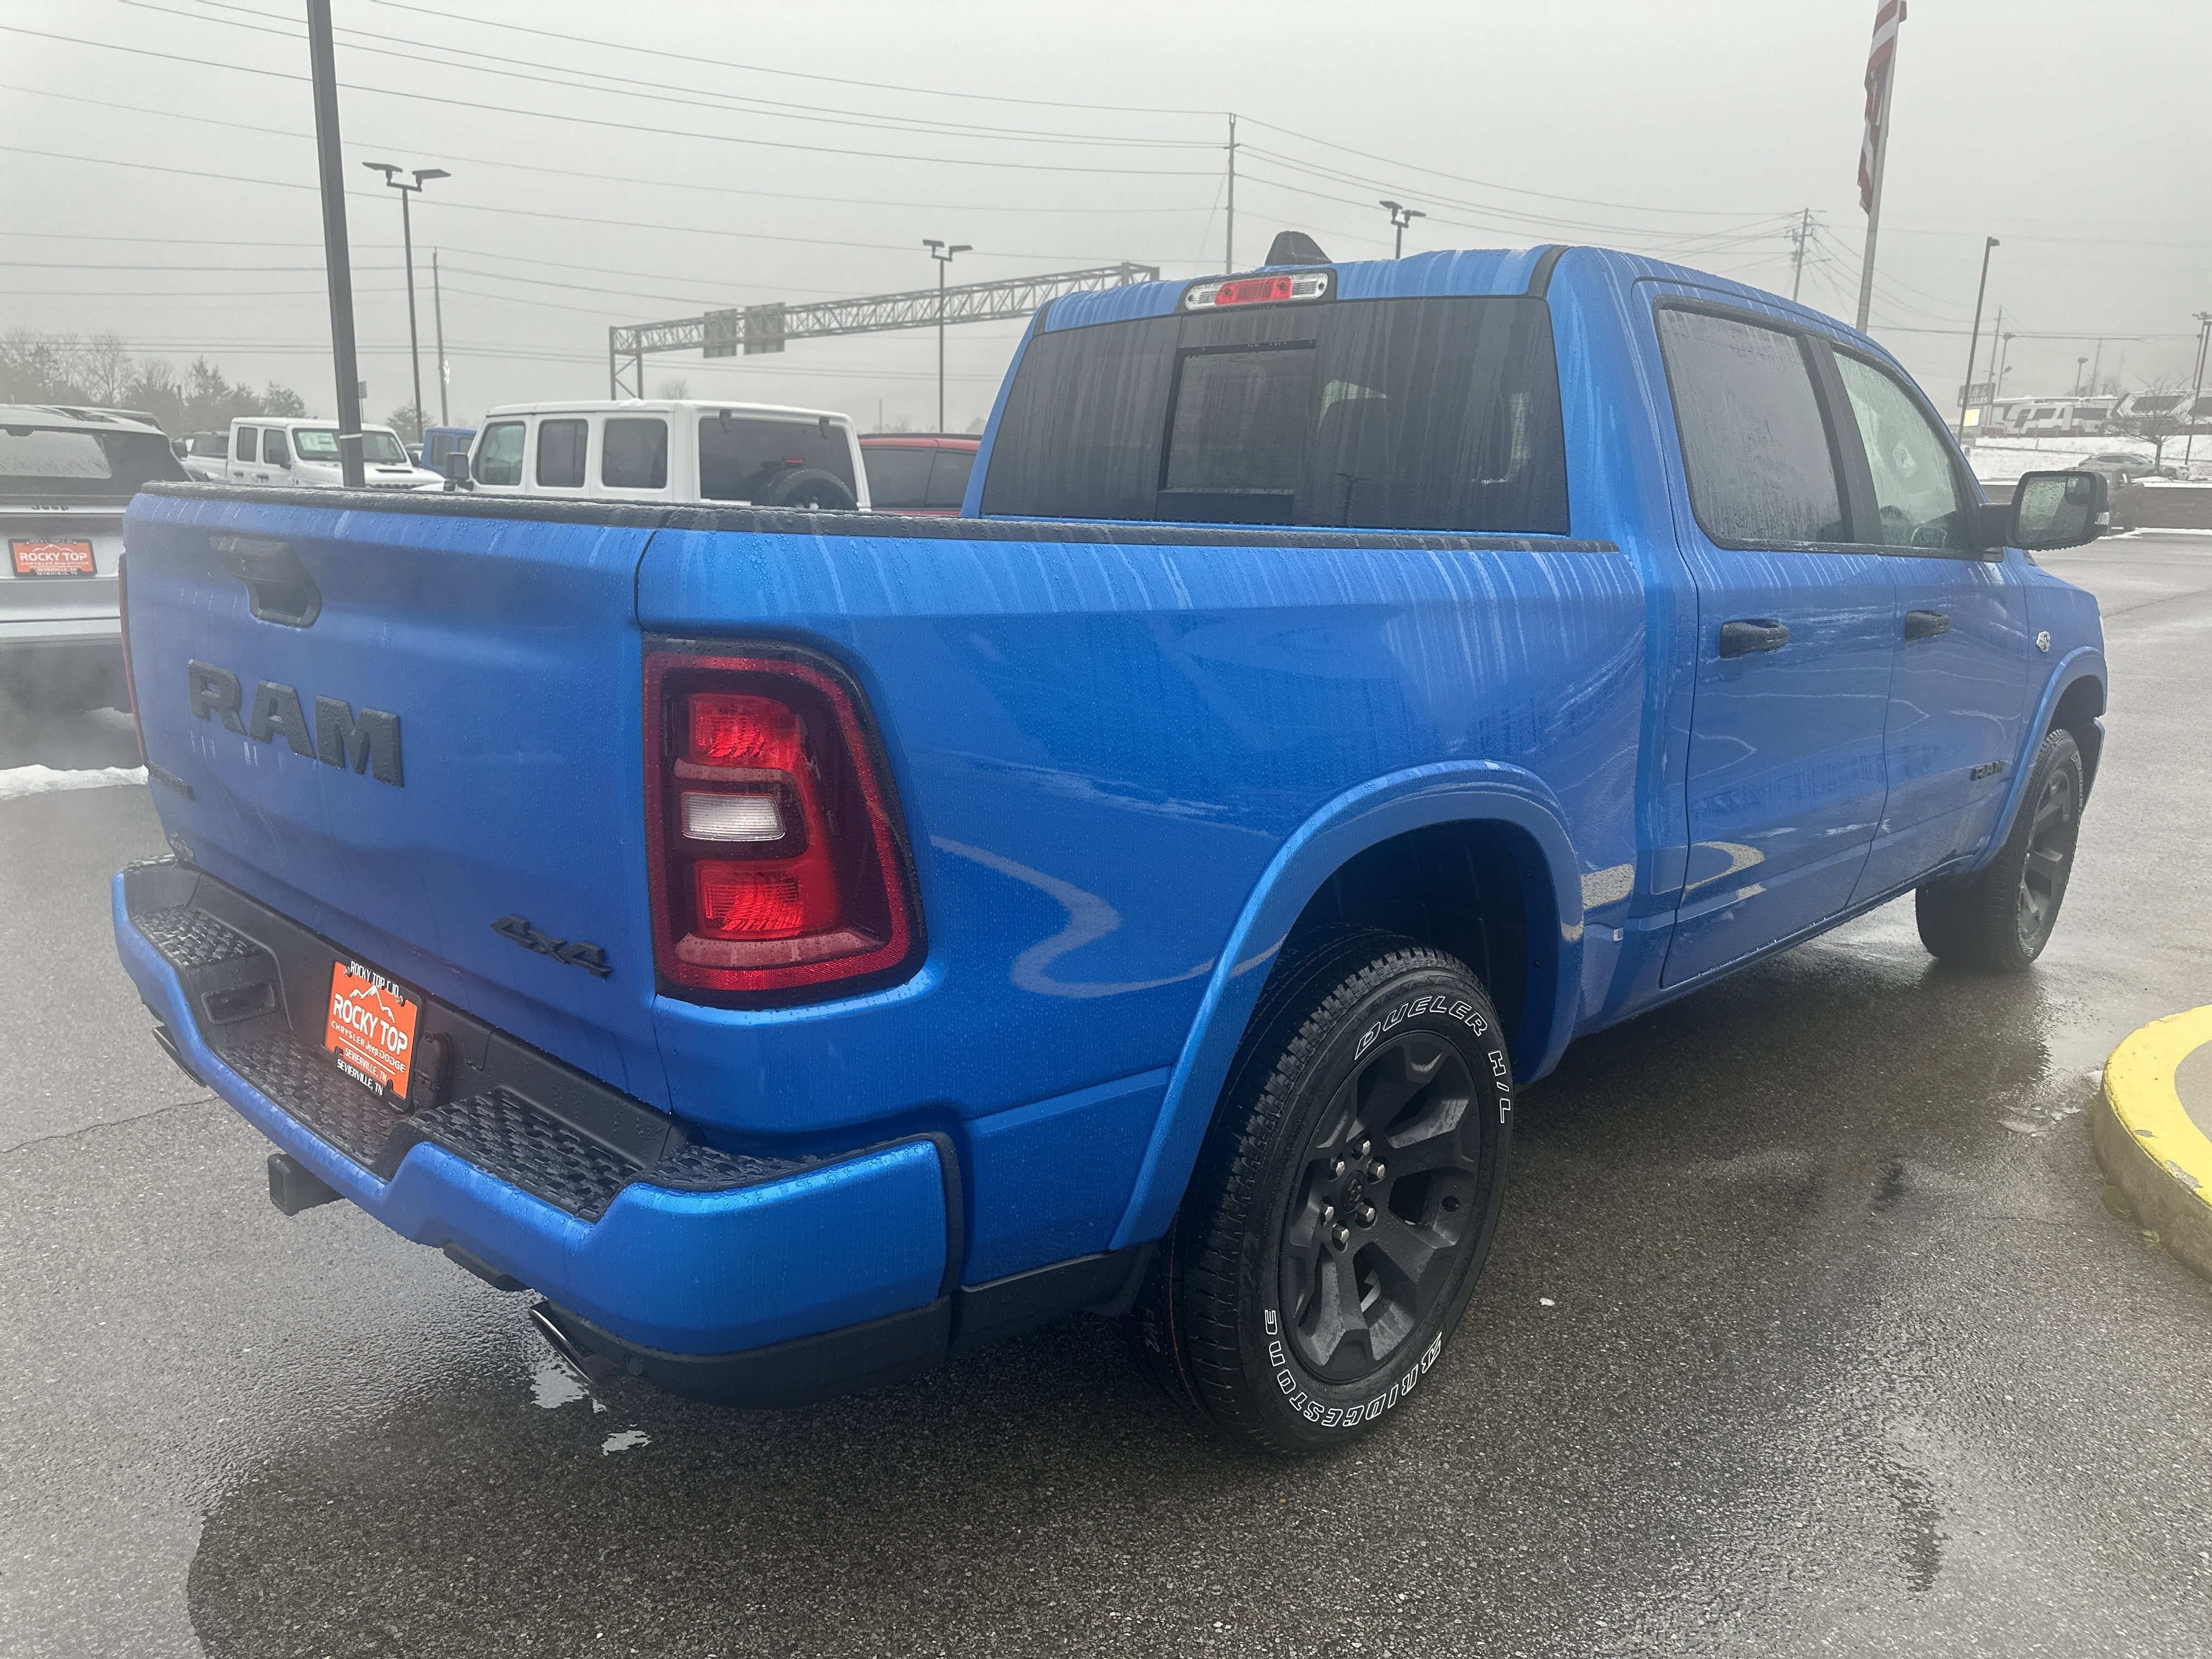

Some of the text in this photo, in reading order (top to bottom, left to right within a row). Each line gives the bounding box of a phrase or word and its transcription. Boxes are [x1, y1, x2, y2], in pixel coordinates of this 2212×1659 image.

[19, 552, 88, 561] ROCKY TOP
[187, 658, 405, 788] RAM
[351, 961, 371, 983] ROCKY
[373, 972, 385, 990] TOP
[331, 1020, 406, 1074] CHRYSLER Jeep DODGE
[333, 992, 408, 1056] ROCKY TOP
[337, 1058, 384, 1096] SEVIERVILLE, TN
[345, 1047, 387, 1082] SEVIERVILLE, TN
[1354, 996, 1511, 1124] DUELER H/L
[1265, 1309, 1442, 1427] BRIDGESTONE
